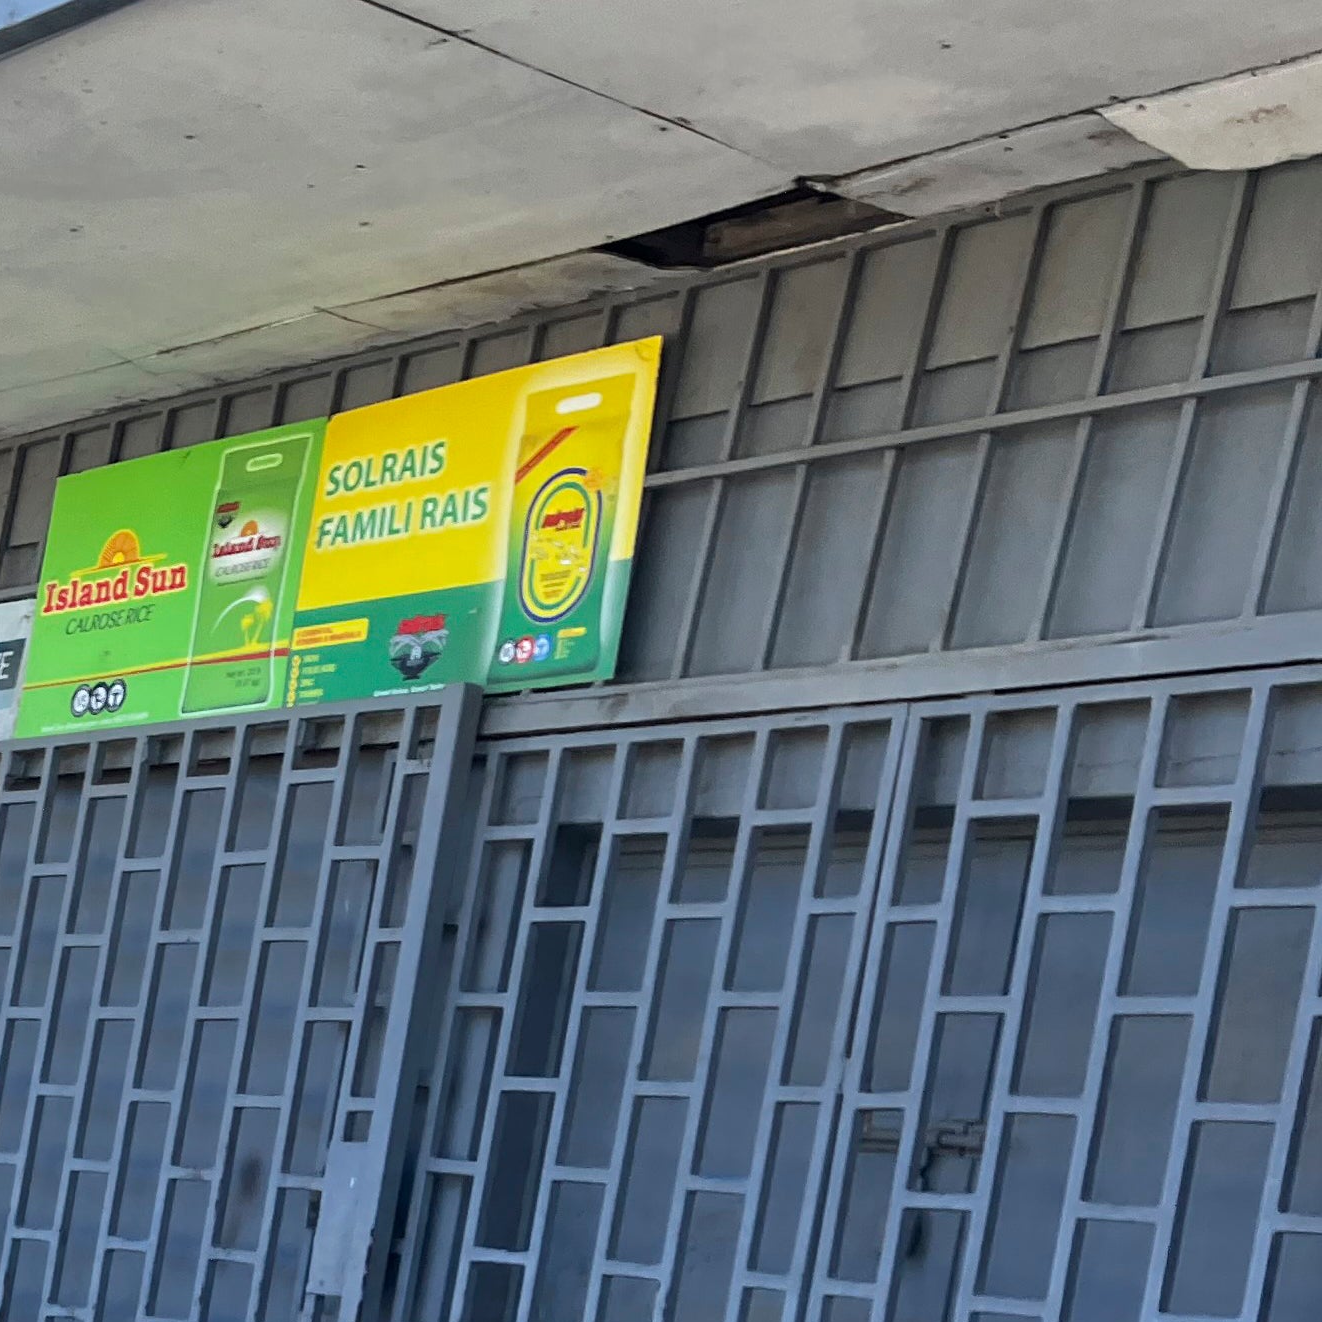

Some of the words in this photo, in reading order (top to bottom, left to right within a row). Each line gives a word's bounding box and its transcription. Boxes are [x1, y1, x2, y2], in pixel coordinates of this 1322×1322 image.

[325, 440, 447, 497] SOLRAIS
[315, 502, 413, 549] FAMILI
[419, 486, 490, 530] RAIS
[41, 567, 130, 615] Island
[133, 564, 188, 598] Sun
[65, 607, 125, 635] CALROSE
[125, 603, 156, 624] RICE
